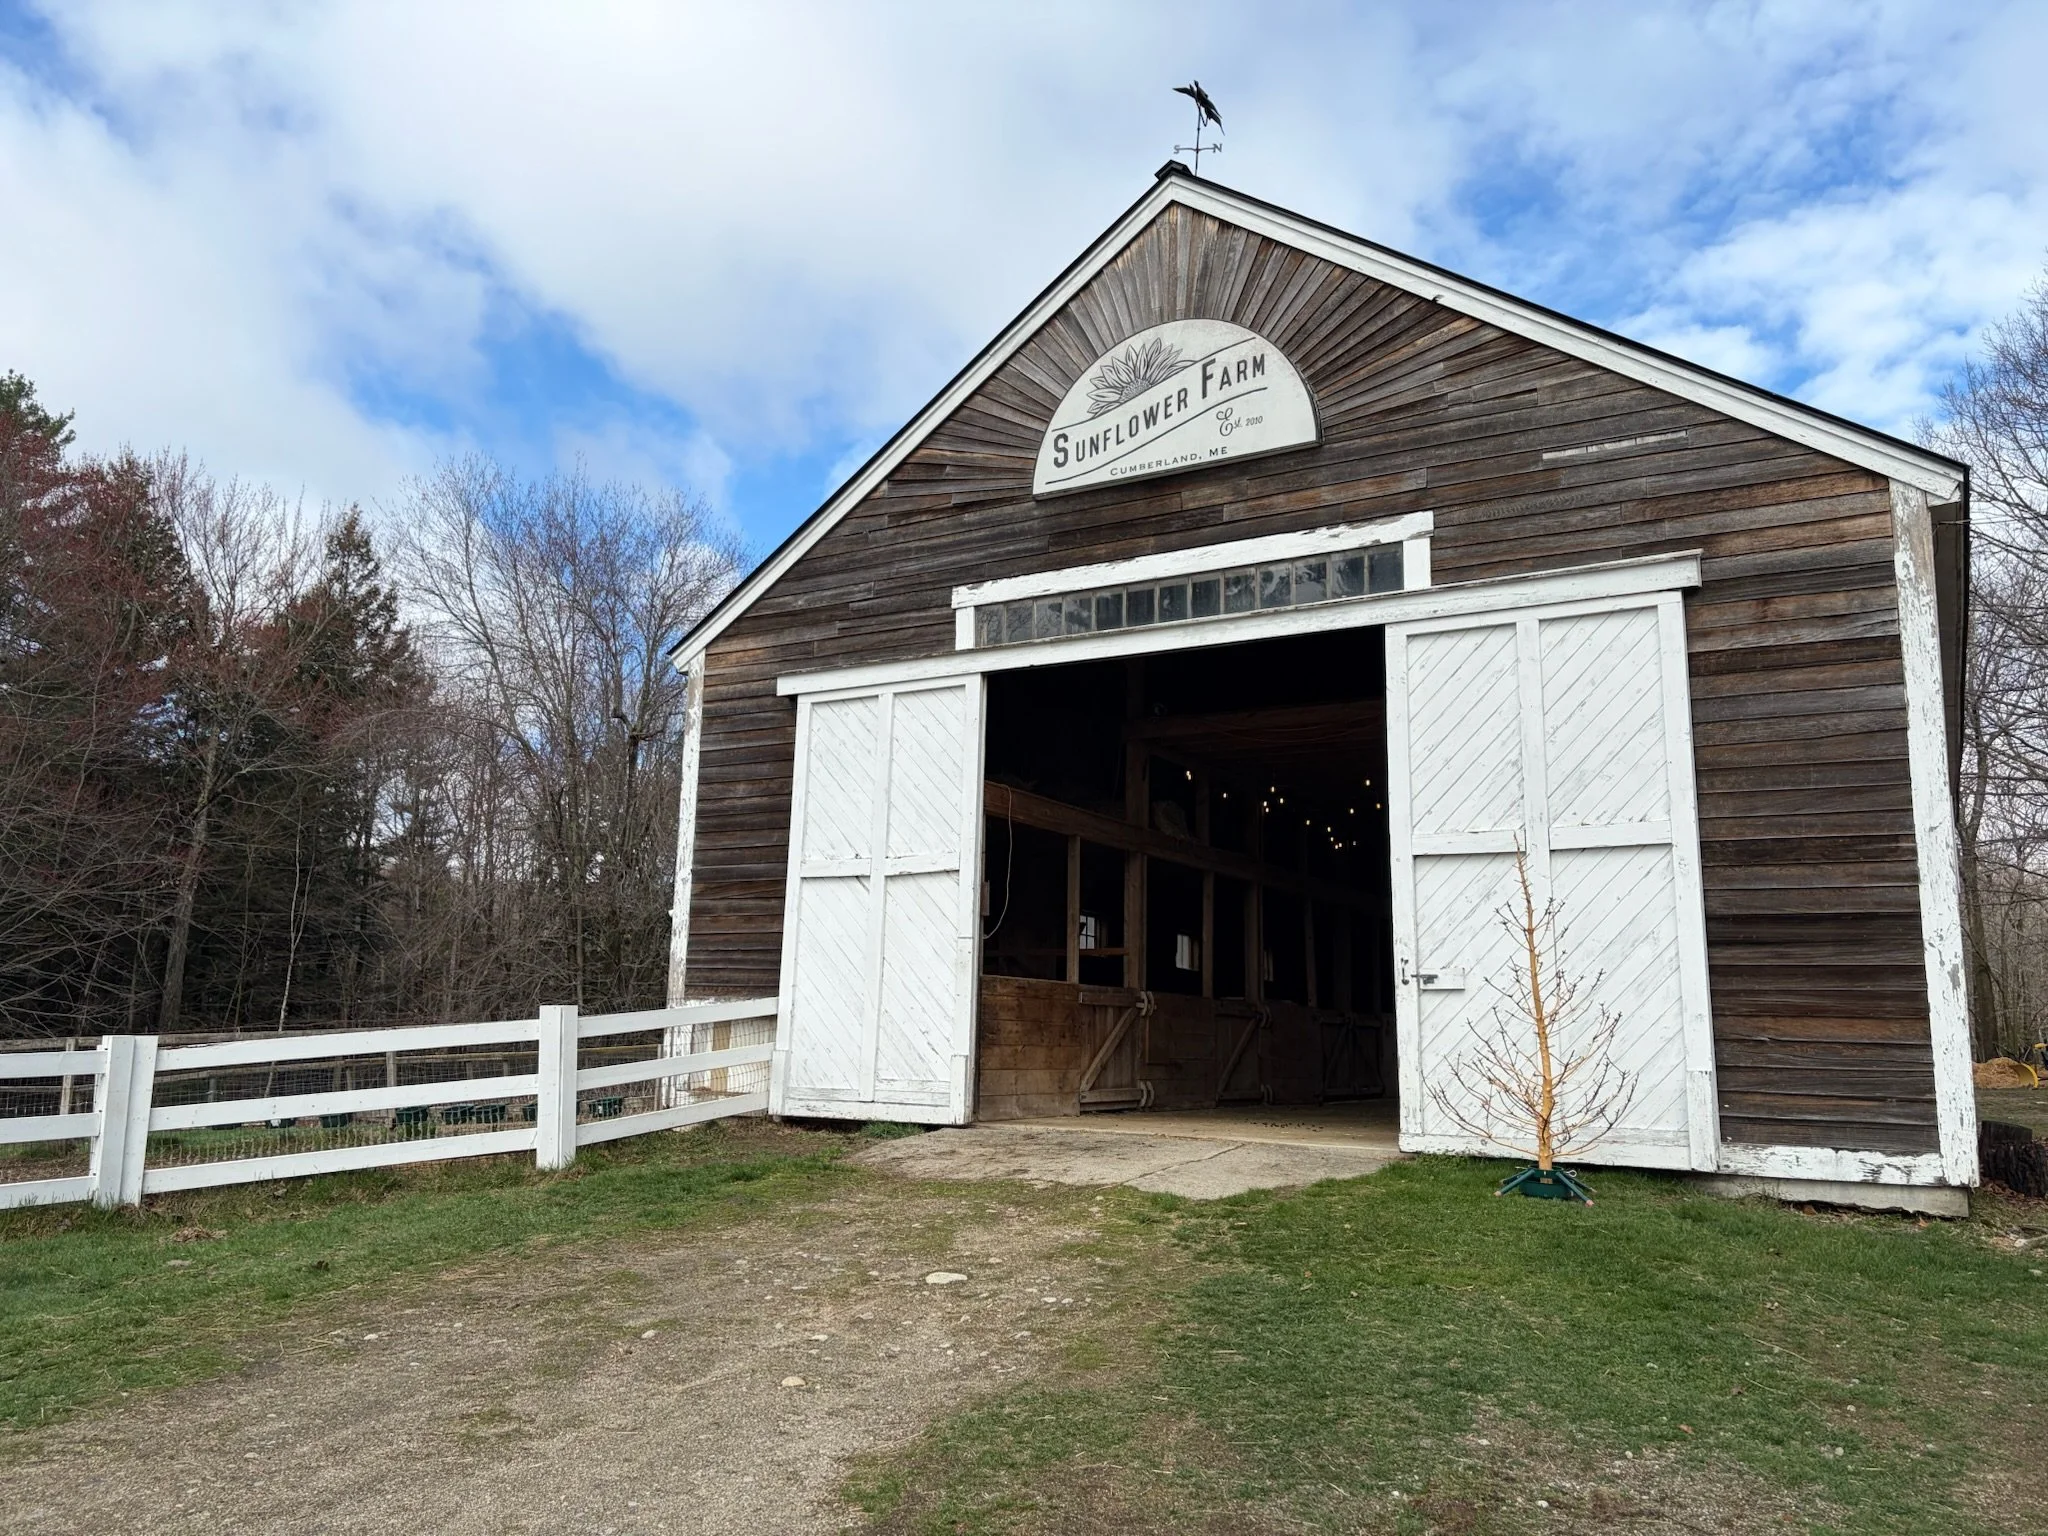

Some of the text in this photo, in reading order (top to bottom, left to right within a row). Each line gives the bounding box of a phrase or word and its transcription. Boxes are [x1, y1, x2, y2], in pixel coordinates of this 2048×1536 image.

[1173, 143, 1222, 154] S N
[1053, 353, 1265, 468] SUNFLOWER FARM
[1245, 415, 1263, 427] 2010
[1110, 446, 1228, 476] CUMBERLAND, ME
